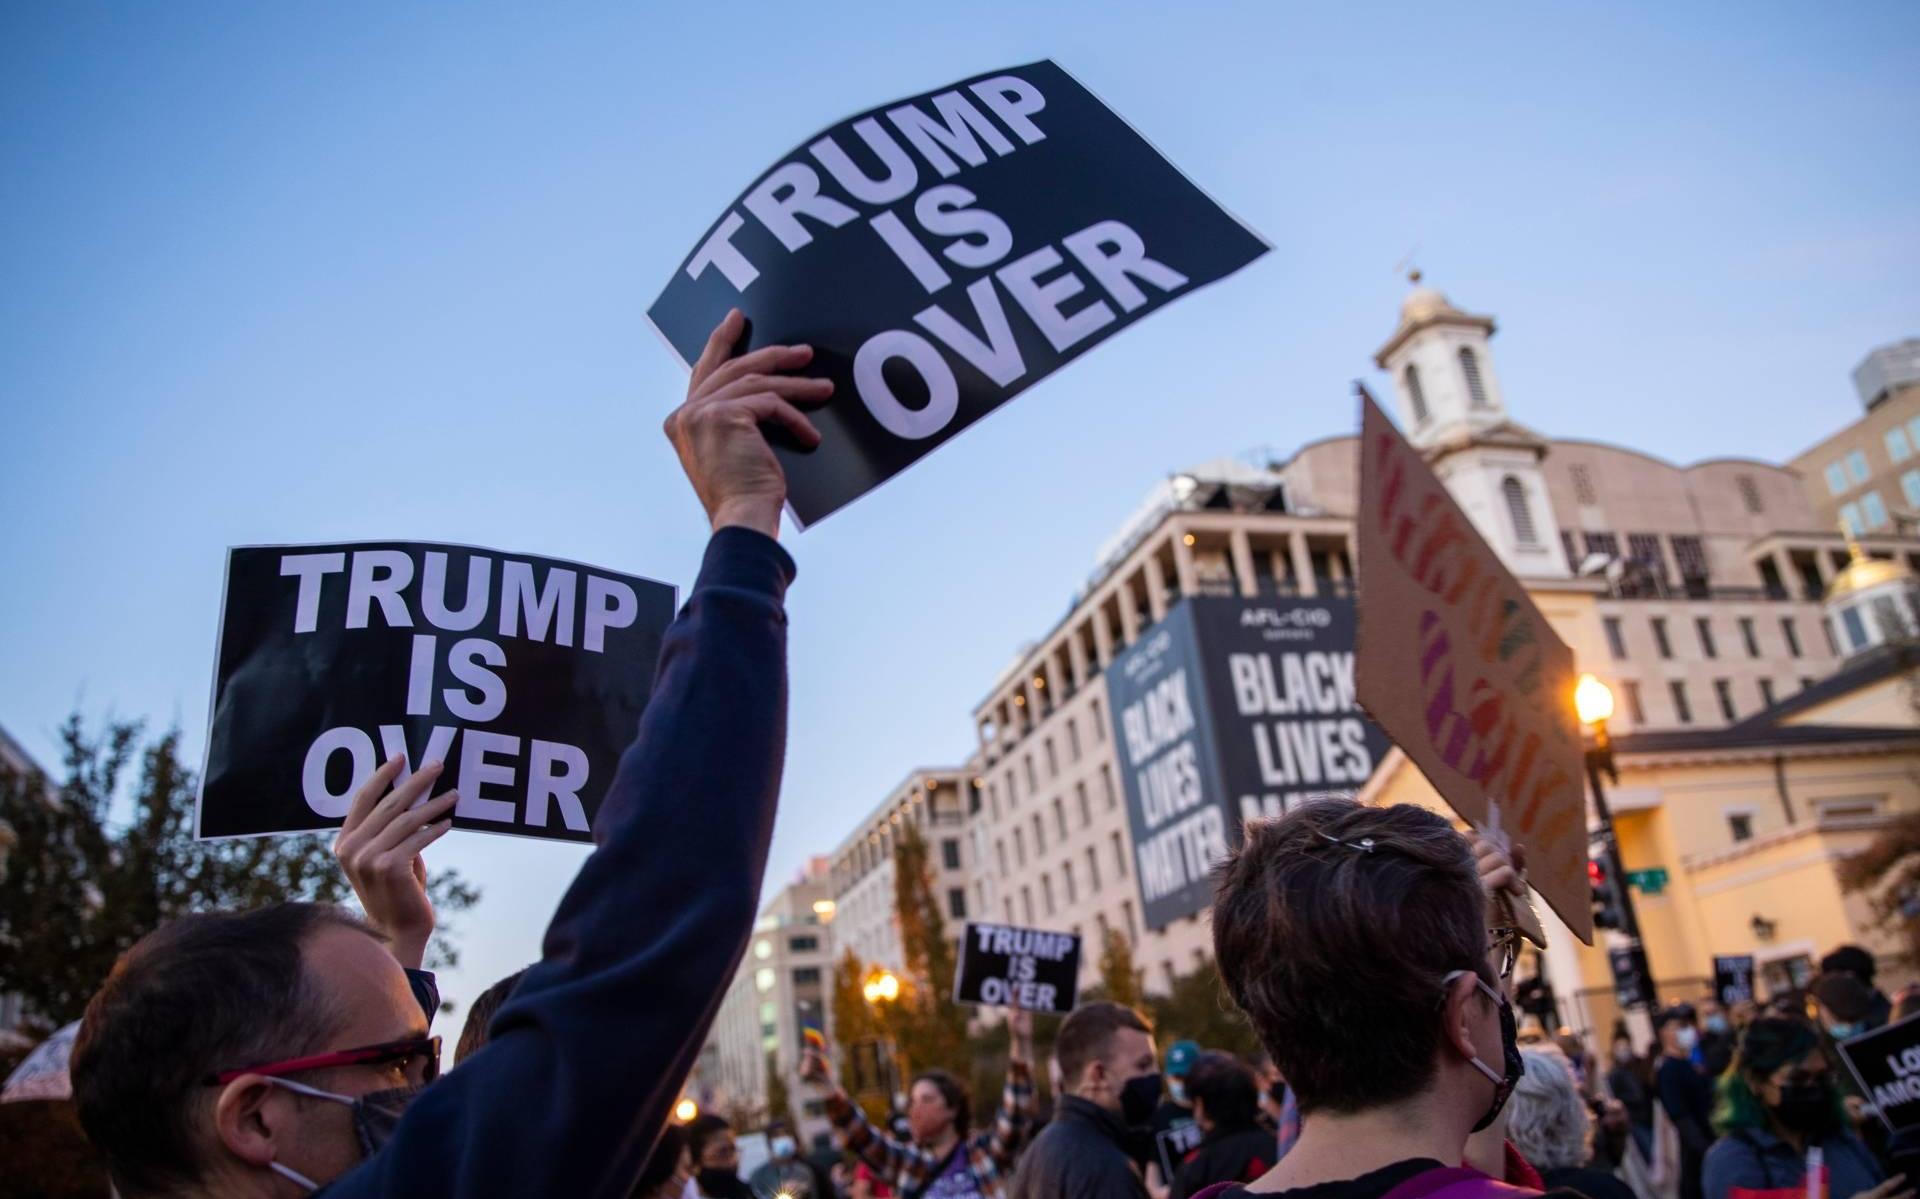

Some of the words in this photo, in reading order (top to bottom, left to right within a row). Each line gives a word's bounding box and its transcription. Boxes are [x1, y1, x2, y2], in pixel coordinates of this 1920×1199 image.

[685, 74, 1048, 293] TRUMP
[868, 183, 1013, 295] IS
[853, 219, 1190, 441] OVER
[280, 549, 638, 654] TRUMP
[406, 634, 508, 723] IS
[1228, 651, 1358, 716] BLACK
[302, 725, 591, 833] OVER
[1252, 717, 1373, 787] LIVES
[975, 926, 1074, 962] TRUMP
[1007, 955, 1037, 980] IS
[1886, 1044, 1920, 1077] LO
